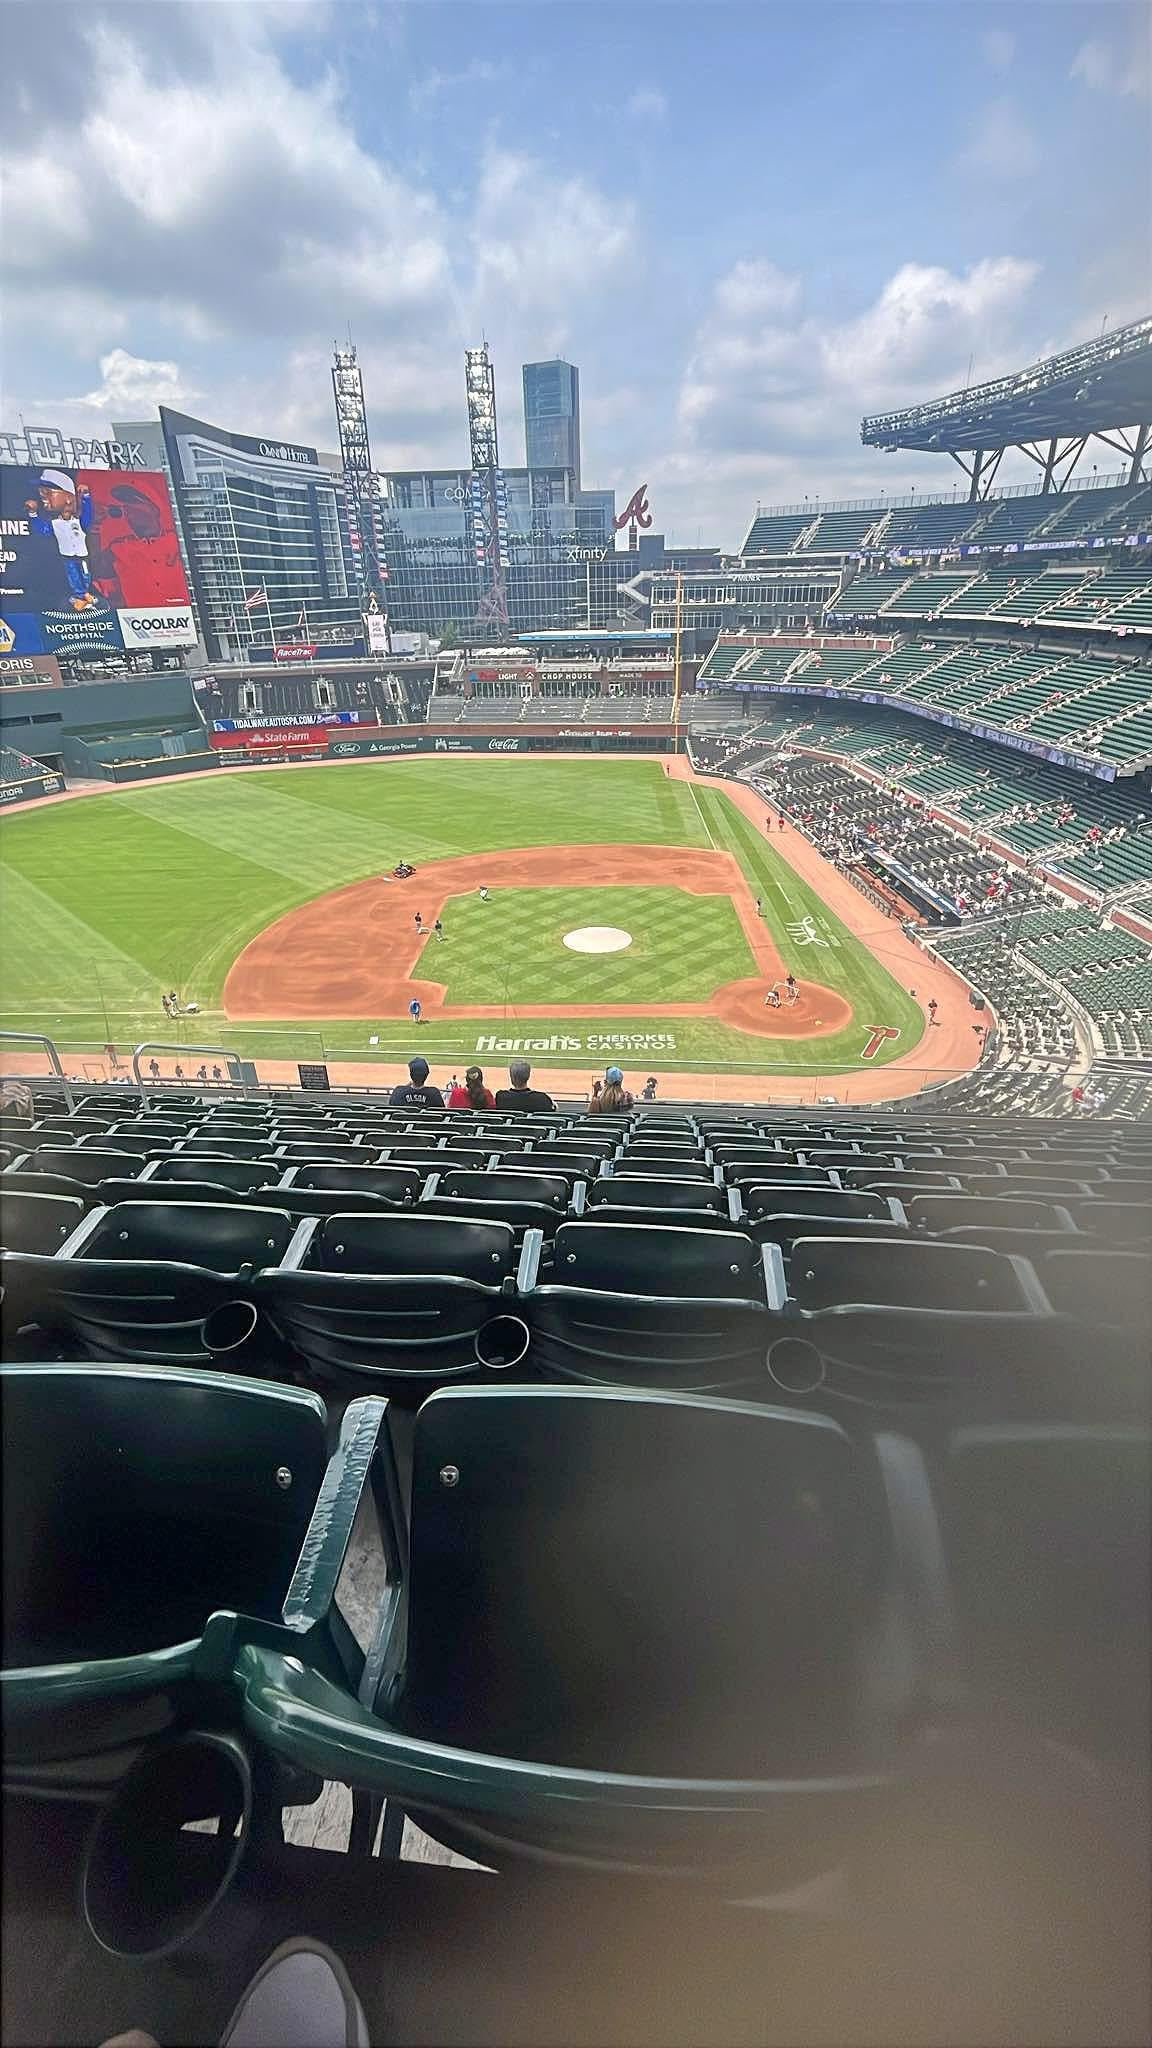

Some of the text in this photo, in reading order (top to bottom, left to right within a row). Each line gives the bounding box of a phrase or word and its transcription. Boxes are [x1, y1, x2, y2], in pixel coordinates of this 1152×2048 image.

[71, 438, 145, 465] PARK
[45, 622, 114, 634] NORTHSIDE
[131, 617, 189, 630] COOLRAY
[277, 648, 312, 657] RaceTrac
[565, 672, 593, 680] HOUSE
[587, 1034, 676, 1042] CHEROKEE
[586, 1042, 677, 1050] CASINOS
